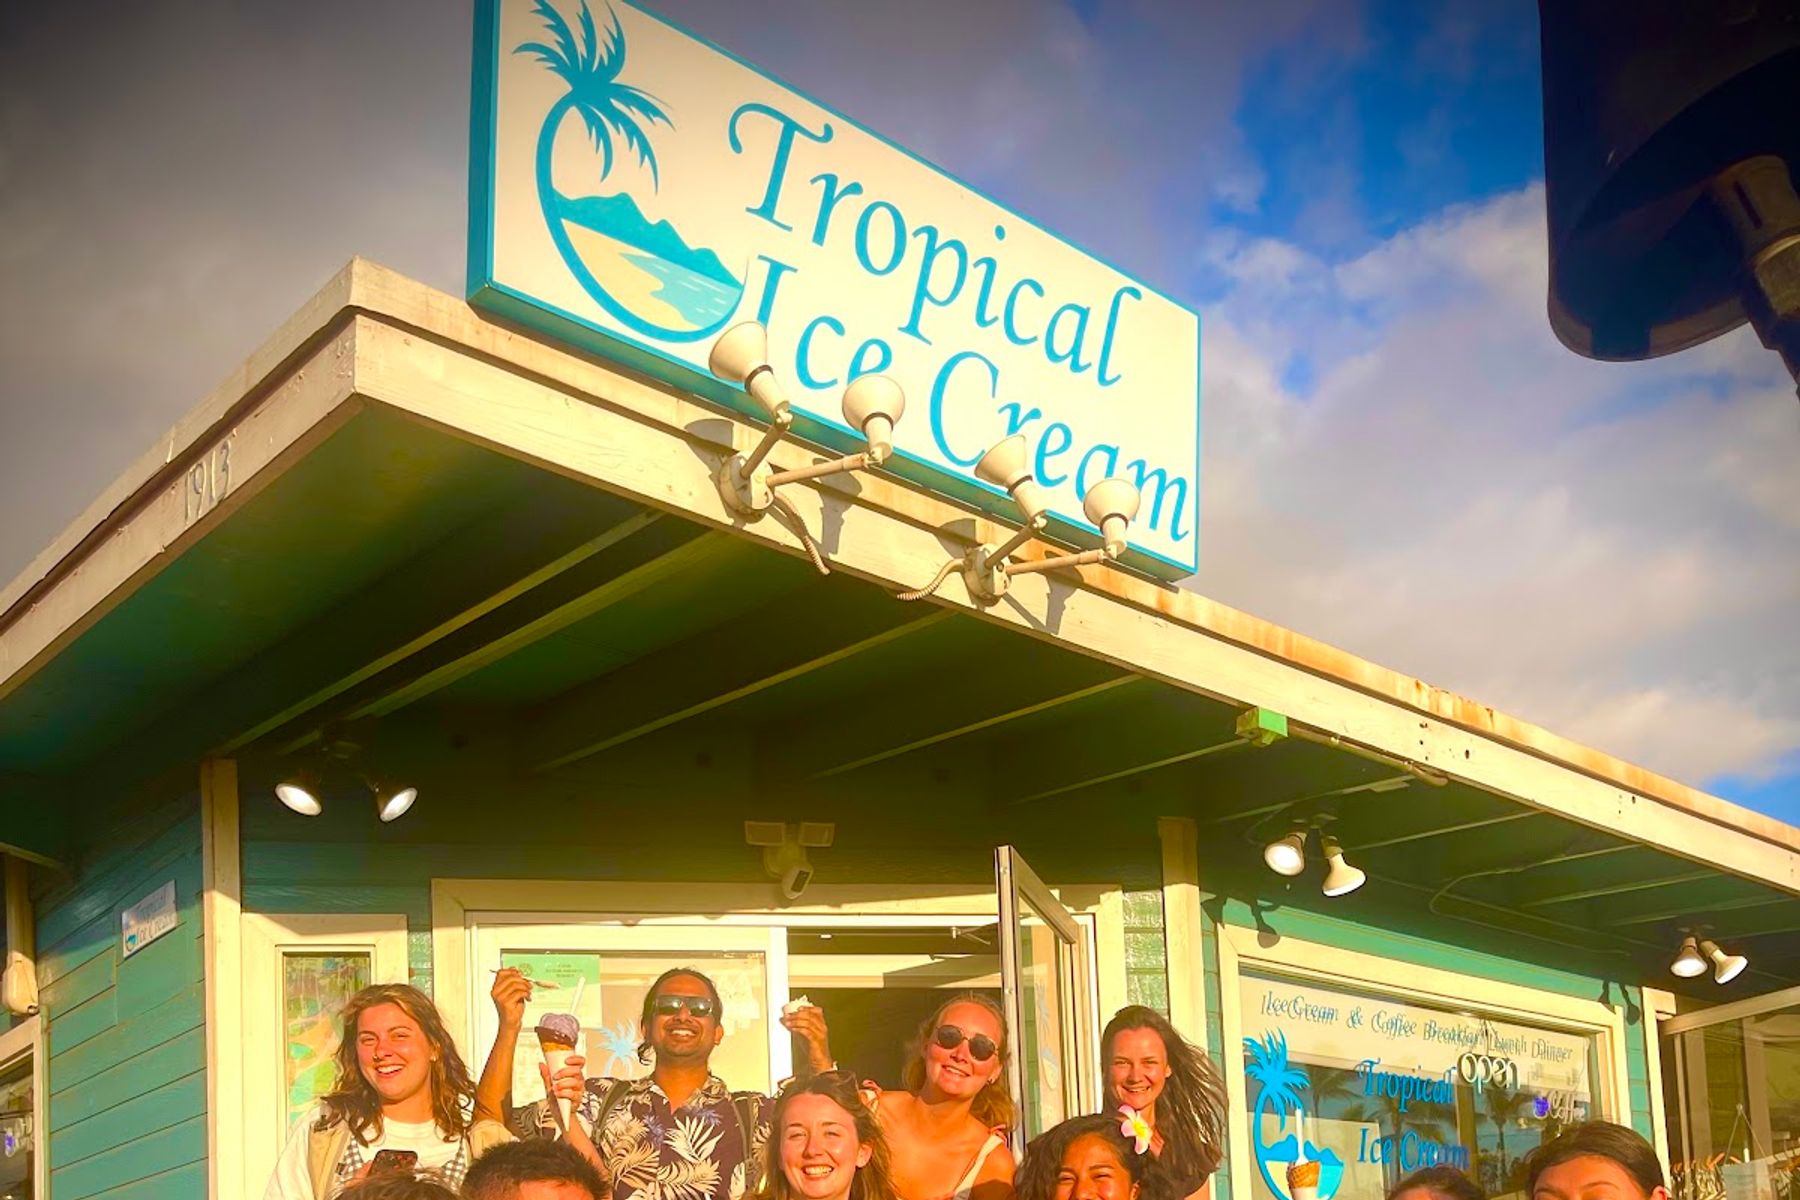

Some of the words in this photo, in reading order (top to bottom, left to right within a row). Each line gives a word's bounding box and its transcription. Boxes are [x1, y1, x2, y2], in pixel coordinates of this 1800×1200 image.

[728, 102, 1142, 387] Tropical
[755, 254, 892, 390] Ice
[929, 350, 1190, 542] Cream
[184, 439, 231, 524] 1913
[1347, 1006, 1364, 1029] &
[1371, 1010, 1418, 1040] Coffee
[1531, 1038, 1574, 1063] Dinner
[1353, 1058, 1457, 1114] Tropical
[1547, 1090, 1586, 1125] Coffee
[1357, 1128, 1393, 1164] Ice
[1400, 1130, 1470, 1172] Cream
